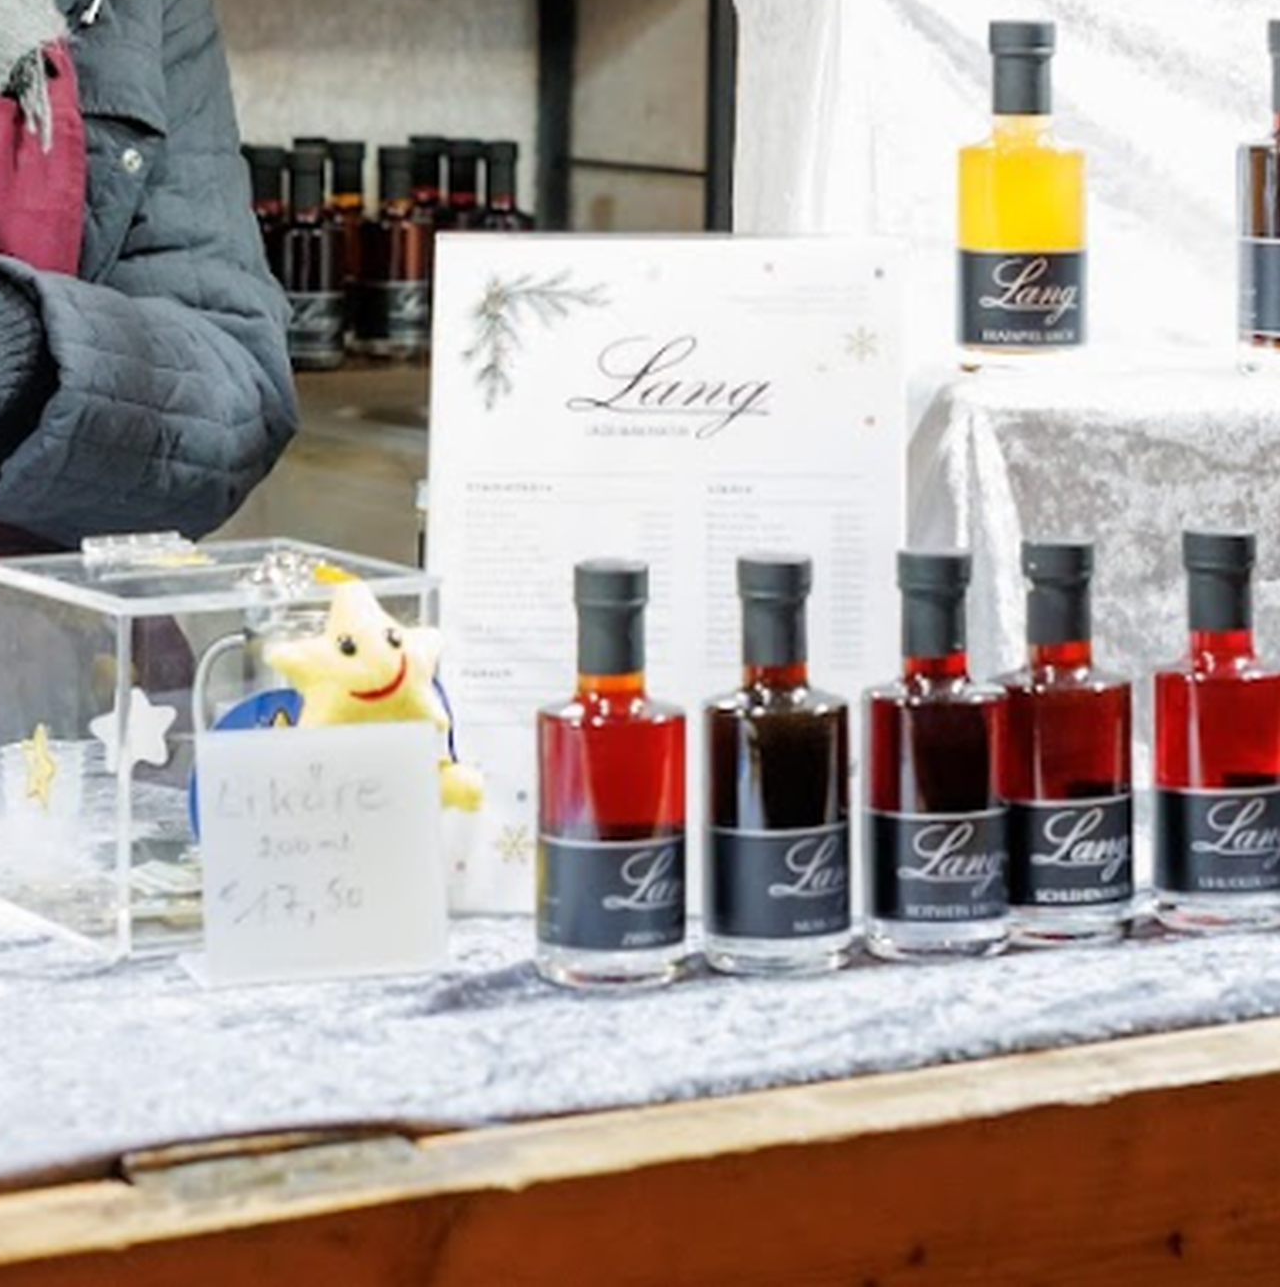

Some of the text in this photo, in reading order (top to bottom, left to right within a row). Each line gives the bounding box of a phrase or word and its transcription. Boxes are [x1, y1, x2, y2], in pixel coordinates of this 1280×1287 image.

[978, 256, 1078, 326] Lang
[567, 335, 772, 440] Lang
[602, 847, 682, 910] La
[768, 835, 847, 898] Lan
[897, 822, 1006, 899] Lang
[1030, 807, 1129, 883] Lang
